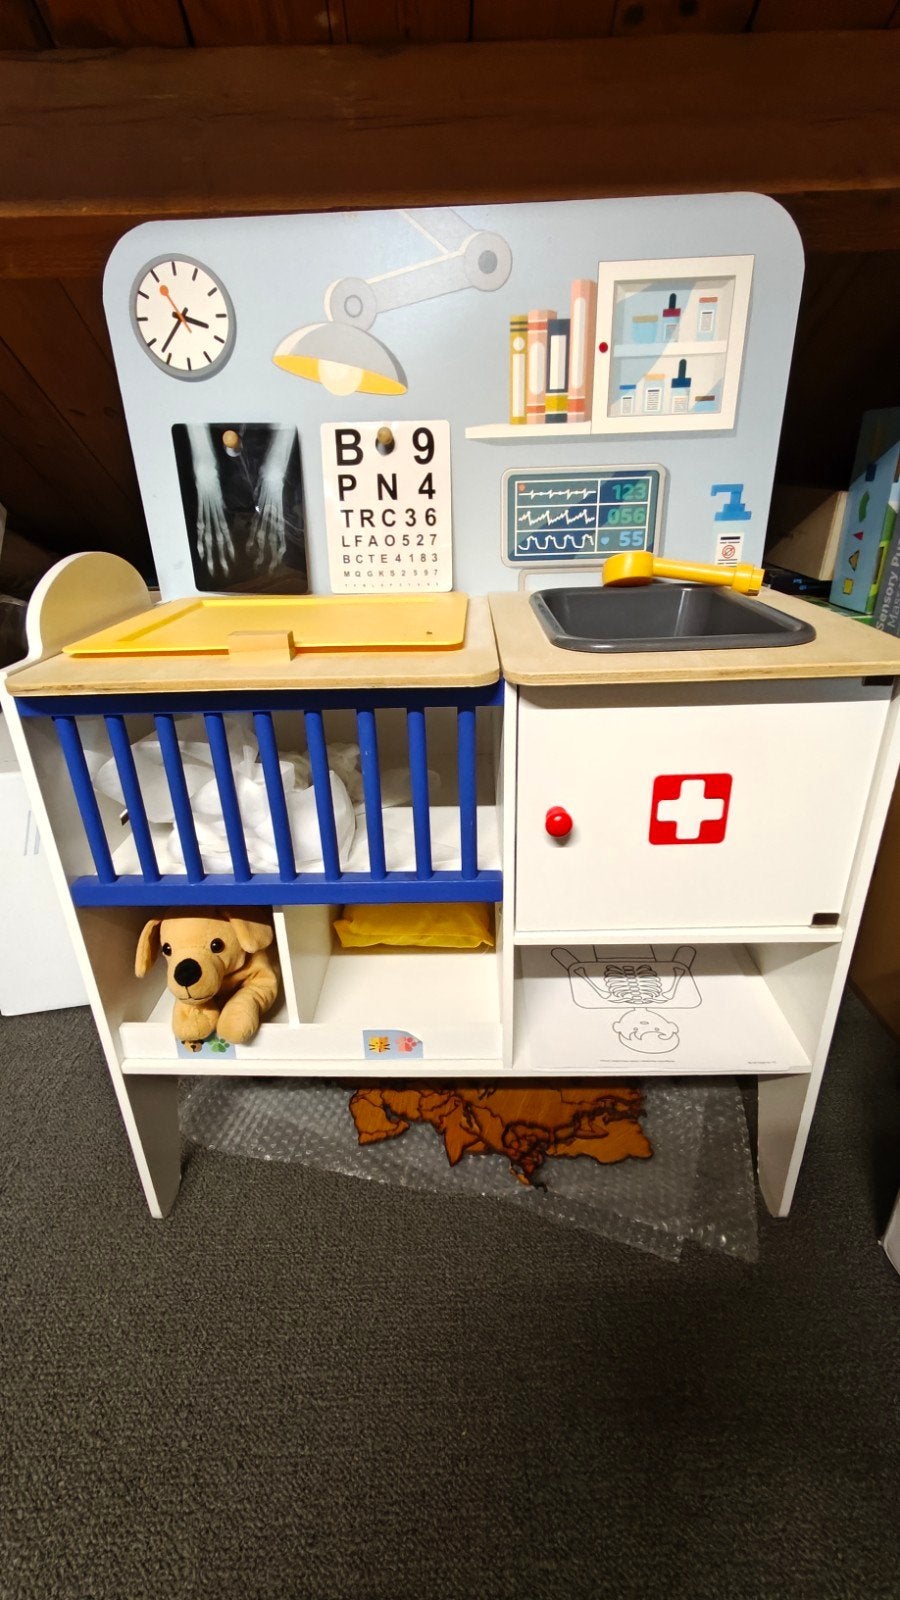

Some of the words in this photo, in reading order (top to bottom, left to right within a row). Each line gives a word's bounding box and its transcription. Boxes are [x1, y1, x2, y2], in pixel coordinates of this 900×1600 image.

[334, 428, 364, 467] B
[412, 427, 435, 465] 9
[337, 474, 357, 501] P
[377, 473, 398, 501] N
[418, 472, 436, 500] 4
[612, 482, 648, 500] 123
[607, 508, 646, 525] 056
[619, 530, 644, 547] 55
[876, 571, 898, 631] Sensory
